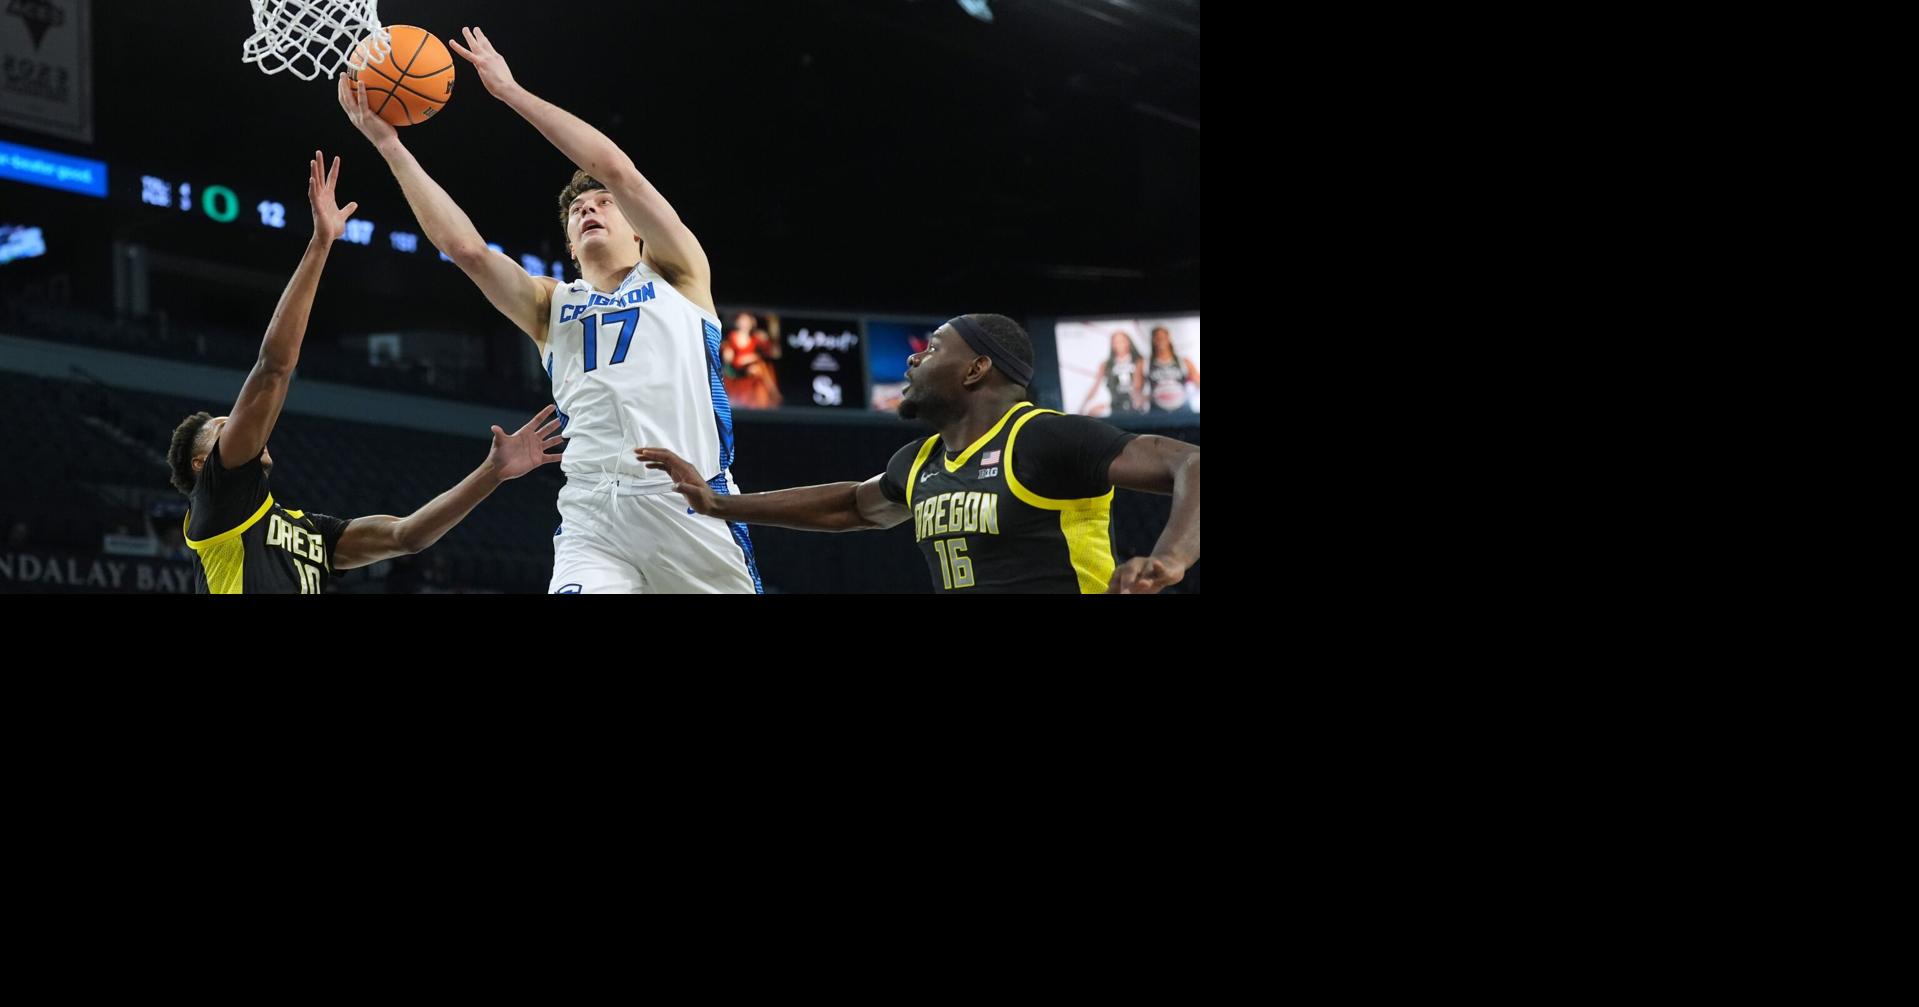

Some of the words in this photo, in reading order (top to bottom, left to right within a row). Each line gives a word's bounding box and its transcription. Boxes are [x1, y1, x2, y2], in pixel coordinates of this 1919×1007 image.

[257, 200, 286, 228] 12
[579, 307, 640, 373] 17
[914, 491, 1000, 543] OREGON
[266, 513, 330, 574] OREG
[934, 538, 975, 590] 16
[136, 564, 193, 594] BAY
[293, 558, 321, 594] 10
